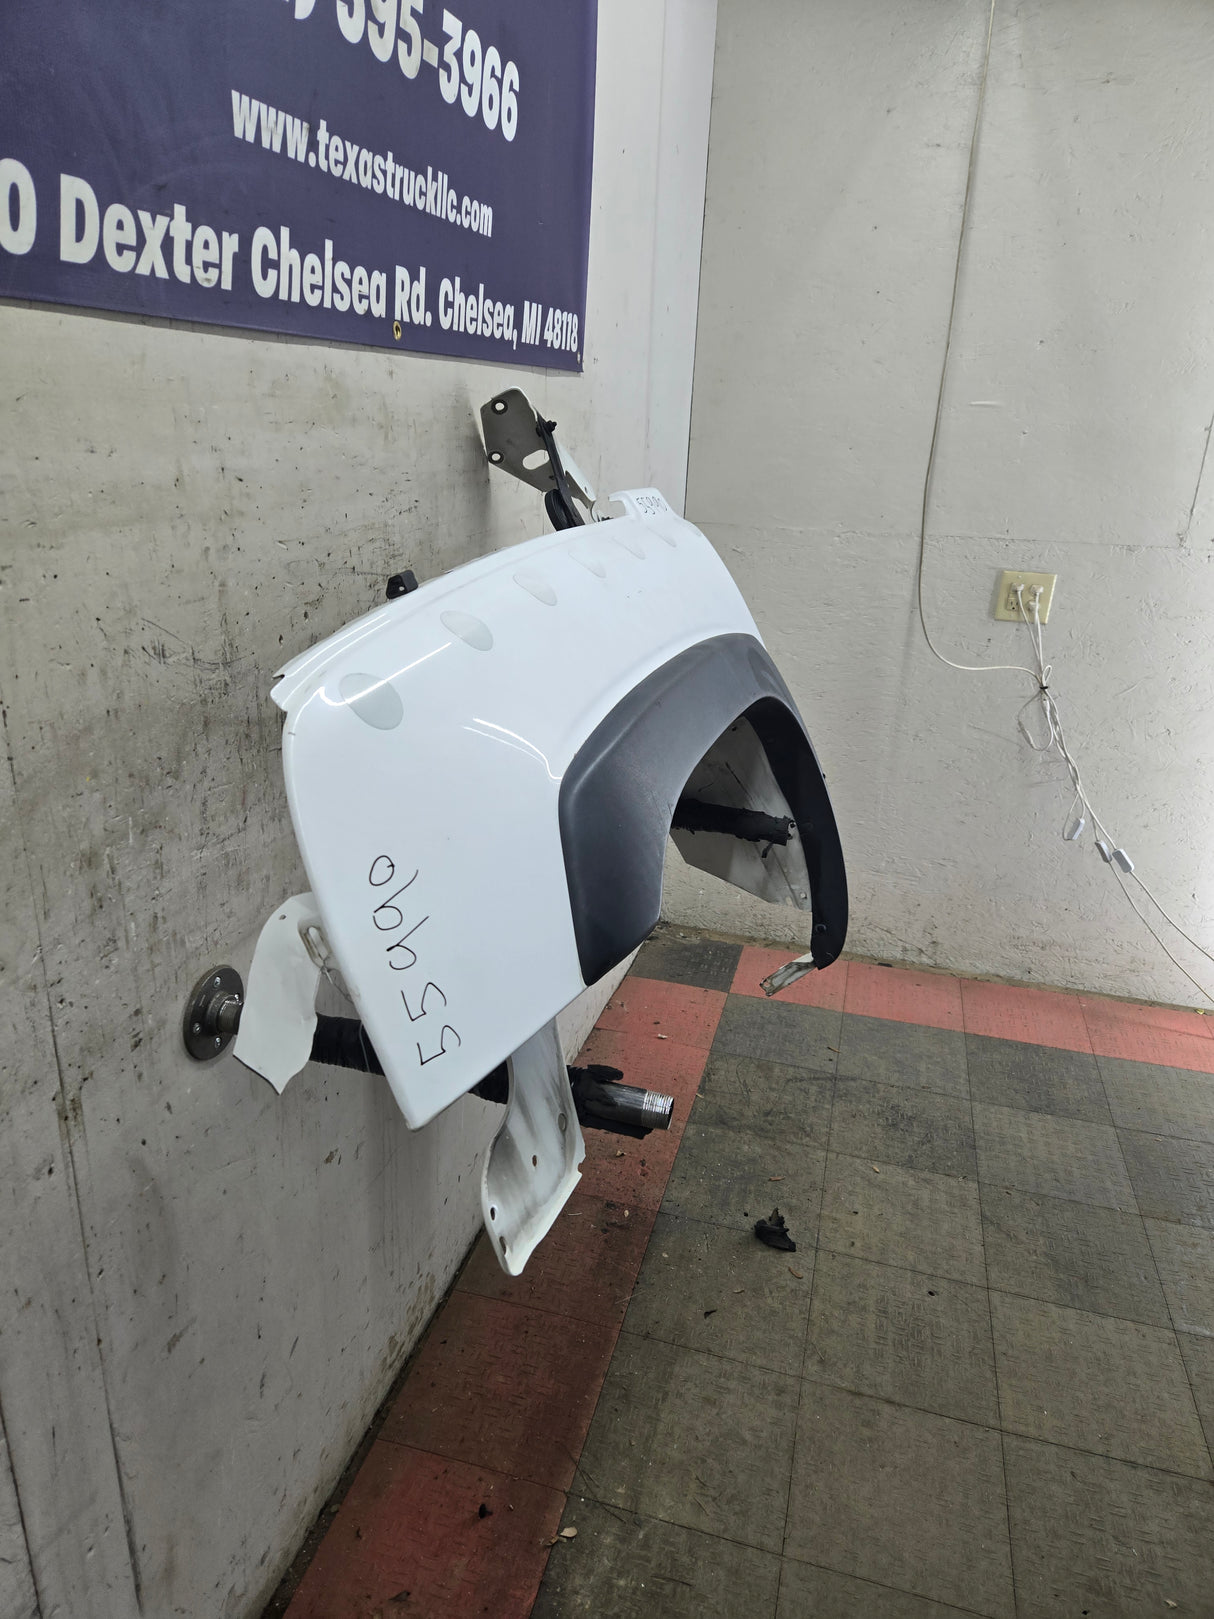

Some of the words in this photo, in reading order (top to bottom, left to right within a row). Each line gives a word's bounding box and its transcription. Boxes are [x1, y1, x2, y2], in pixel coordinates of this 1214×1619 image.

[231, 89, 494, 238] www.texastruckllc.com
[60, 173, 239, 291] Dexter
[251, 225, 387, 318] Chelsea
[394, 264, 432, 327] Rd.
[438, 276, 518, 350] Chelsea,
[521, 300, 543, 346] MI
[543, 307, 579, 352] 48118
[369, 855, 461, 1066] 55990
